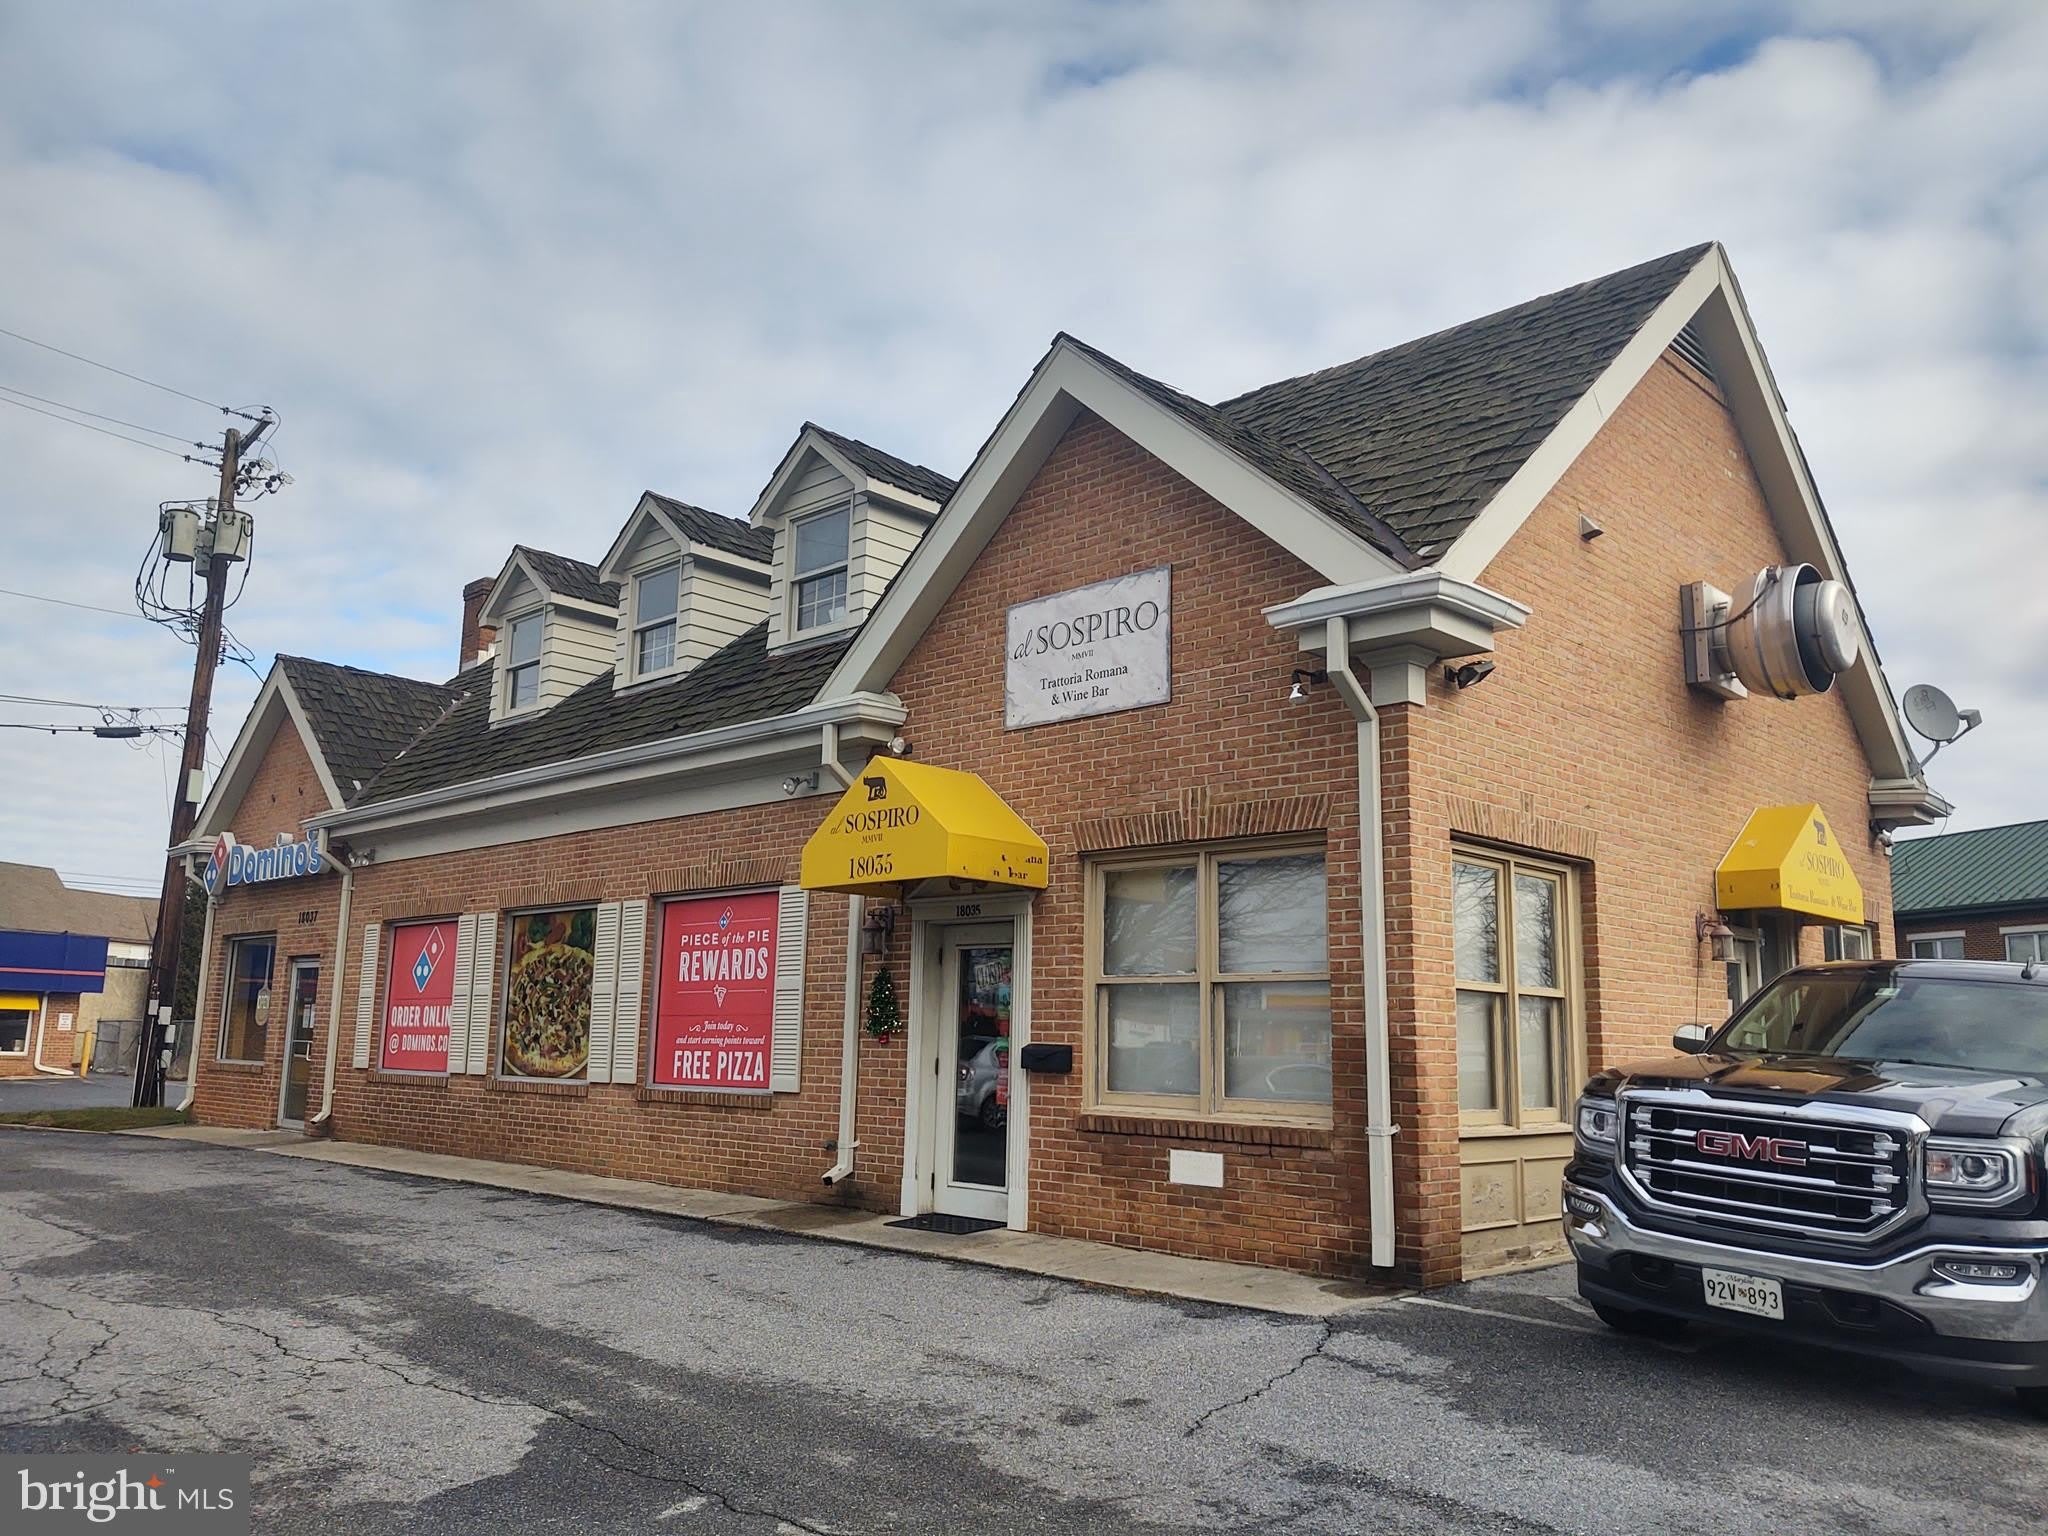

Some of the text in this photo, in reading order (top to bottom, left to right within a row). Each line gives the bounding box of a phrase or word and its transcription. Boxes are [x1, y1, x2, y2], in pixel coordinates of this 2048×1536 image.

[1013, 600, 1159, 660] al SOSPIRO
[1071, 649, 1094, 661] MMVII
[1040, 665, 1128, 690] Trattoria Romana
[1051, 685, 1109, 706] & Wine Bar
[845, 804, 919, 834] SOSPIRO
[861, 833, 883, 845] MMVII
[227, 829, 323, 887] Domino's
[850, 853, 893, 879] 18035
[1807, 851, 1845, 880] SOSPIRO
[298, 911, 319, 925] 18037
[956, 905, 981, 917] 18035
[681, 929, 770, 947] PIECE of the PIE
[679, 947, 769, 982] REWARDS
[391, 1006, 421, 1027] ORDER
[702, 1020, 734, 1033] Join today
[389, 1033, 449, 1054] @ DOMINOS.CO
[687, 1035, 701, 1044] start
[722, 1035, 742, 1048] points
[742, 1035, 766, 1045] toward
[673, 1051, 765, 1081] FREE PIZZA
[1696, 1129, 1807, 1167] GMC
[1726, 1275, 1755, 1285] Maryland
[1707, 1279, 1778, 1310] 92V 893
